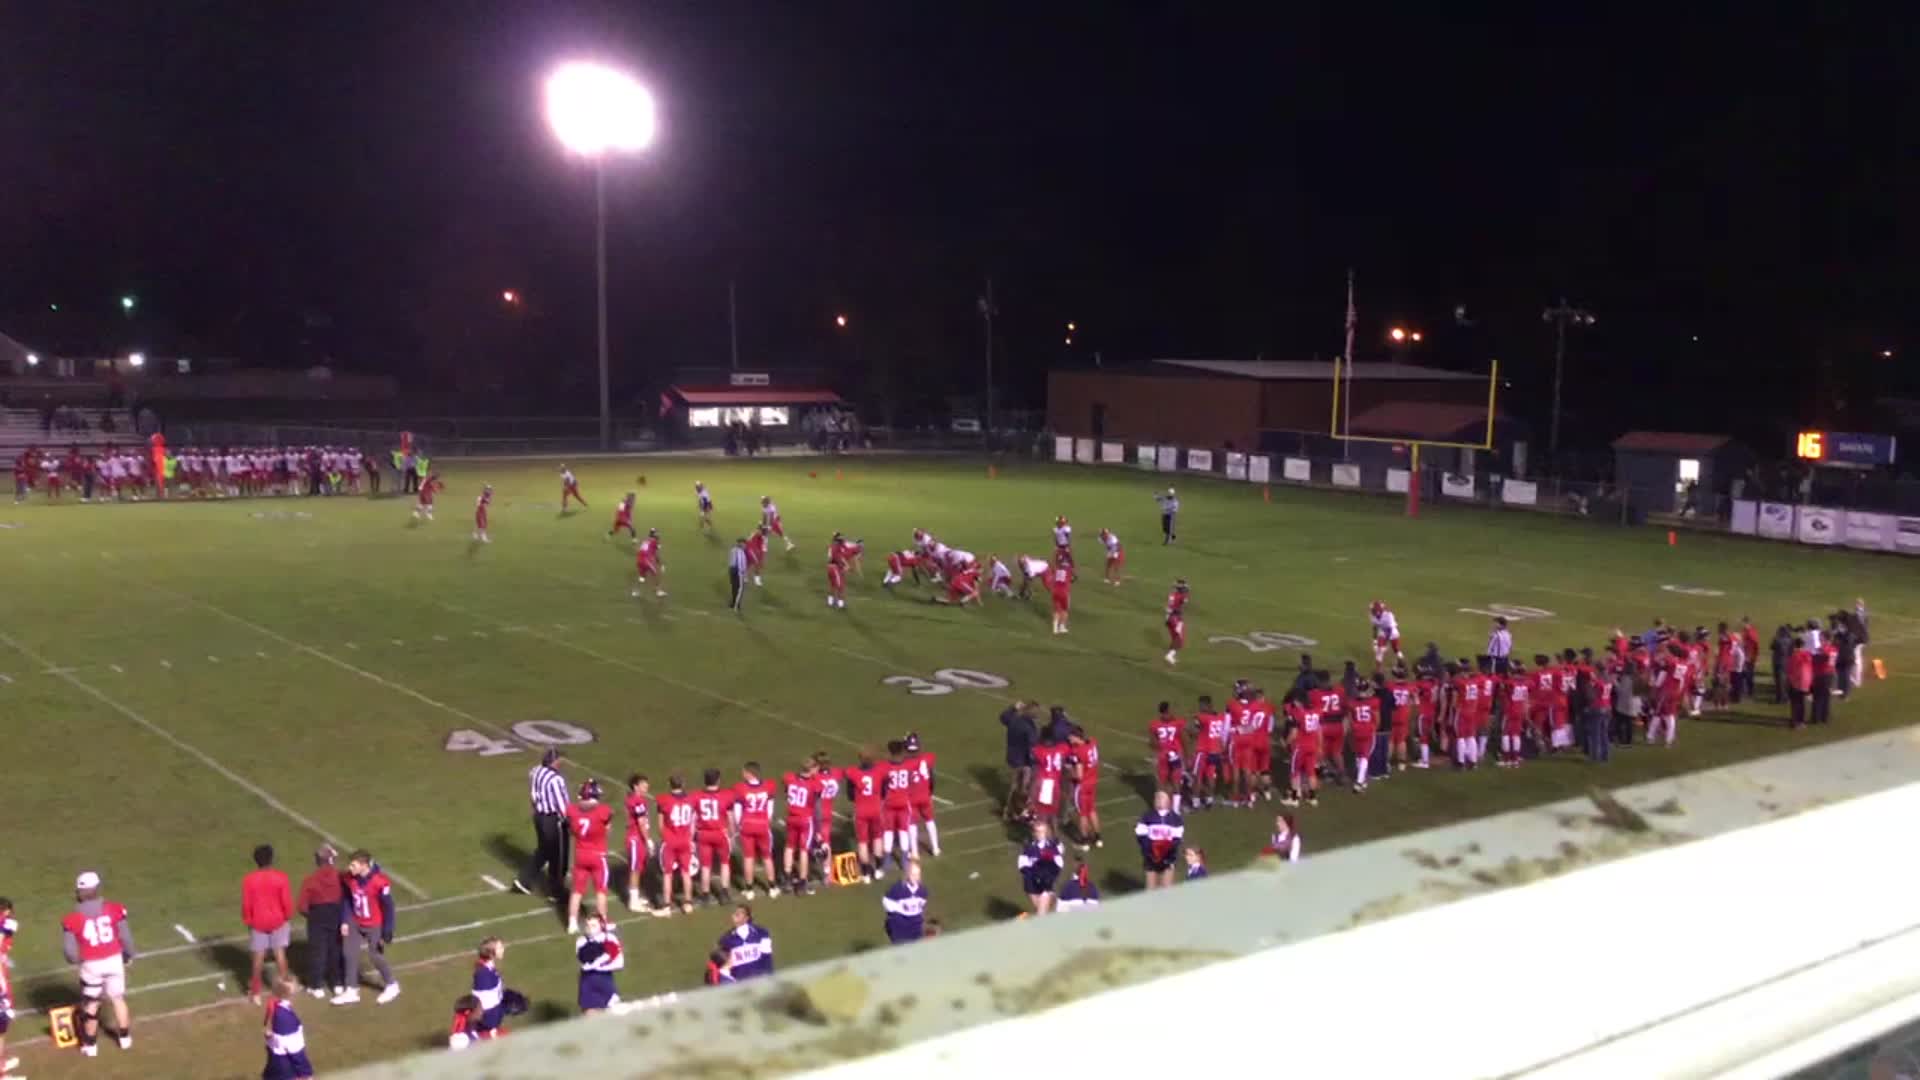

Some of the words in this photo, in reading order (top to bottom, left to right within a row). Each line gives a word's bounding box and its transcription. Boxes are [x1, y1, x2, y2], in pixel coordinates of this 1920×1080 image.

[1797, 432, 1821, 458] 16
[1207, 631, 1319, 652] 20
[881, 667, 1011, 696] 30
[1321, 694, 1341, 712] 72
[1355, 705, 1372, 722] 15
[444, 719, 596, 756] 40
[1045, 752, 1062, 772] 14
[861, 775, 873, 796] 3
[888, 769, 909, 789] 38
[745, 791, 769, 813] 37
[787, 784, 808, 808] 50
[669, 804, 692, 827] 40
[699, 798, 719, 821] 51
[578, 817, 590, 836] 7
[83, 915, 114, 947] 46
